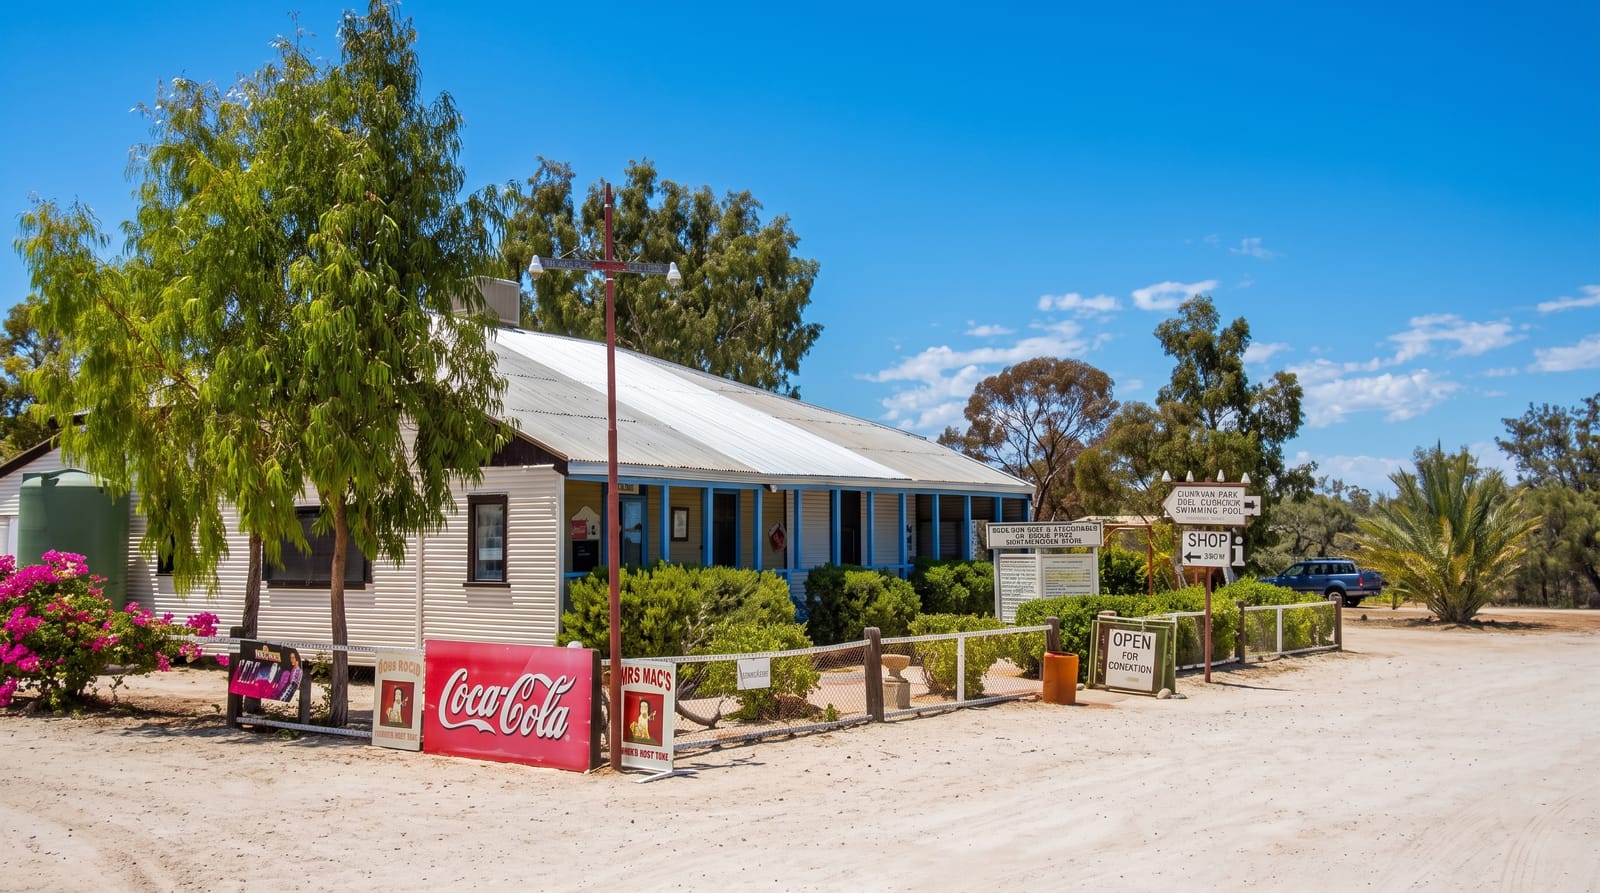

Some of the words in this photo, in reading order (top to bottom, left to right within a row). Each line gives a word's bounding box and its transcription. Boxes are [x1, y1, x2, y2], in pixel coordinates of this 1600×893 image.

[1218, 491, 1238, 499] PARK
[1175, 506, 1218, 514] SWIMMING
[1222, 507, 1244, 515] POOL
[1188, 532, 1228, 548] SHOP
[1113, 632, 1151, 650] OPEN
[1122, 651, 1139, 661] FOR
[621, 666, 640, 685] MRS
[643, 667, 671, 691] MAC'S
[438, 667, 577, 740] Coca-Cola
